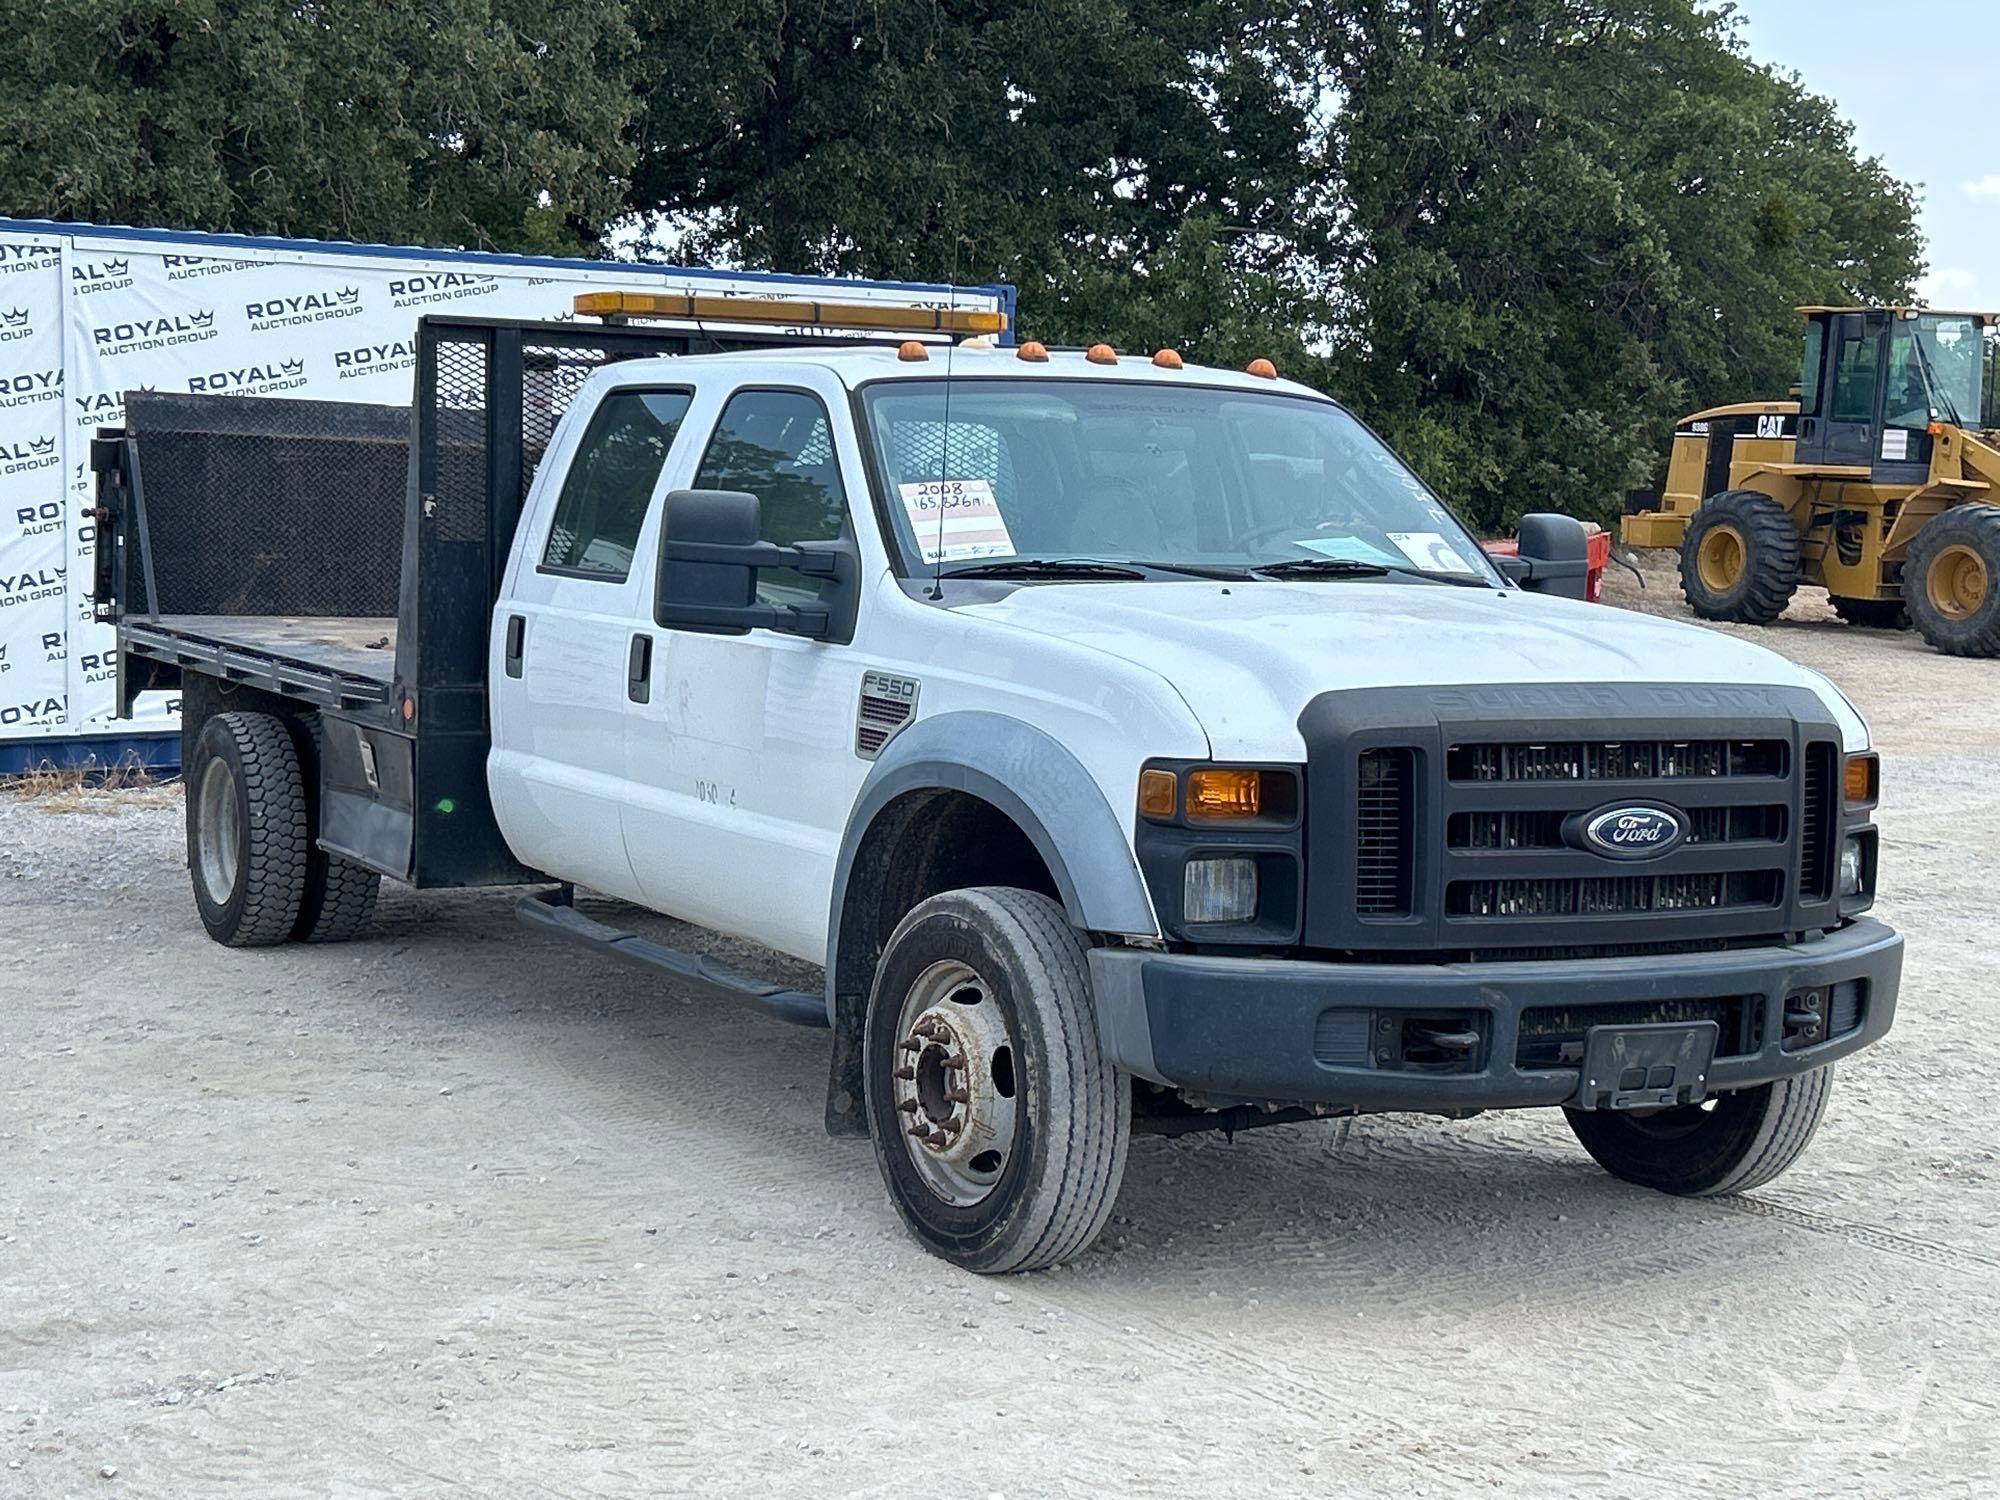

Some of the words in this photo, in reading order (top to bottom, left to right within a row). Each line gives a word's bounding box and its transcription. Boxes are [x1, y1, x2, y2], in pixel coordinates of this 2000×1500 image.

[167, 263, 233, 282] AUCTION
[388, 272, 475, 297] ROYAL
[81, 278, 134, 295] GROUP
[393, 292, 452, 308] AUCTION
[454, 284, 499, 299] GROUP
[246, 292, 337, 320] ROYAL
[93, 316, 191, 345] ROYAL
[250, 313, 313, 332] AUCTION
[315, 305, 363, 322] GROUP
[98, 338, 165, 357] AUCTION
[167, 329, 219, 346] GROUP
[188, 364, 282, 393] ROYAL
[338, 361, 400, 380] AUCTION
[259, 377, 308, 394] GROUP
[1756, 415, 1786, 438] CAT
[5, 456, 60, 475] GROUP
[918, 482, 963, 496] 2008
[1429, 686, 1628, 711] SUPER
[1650, 685, 1776, 708] DUTY
[1613, 816, 1662, 843] Ford
